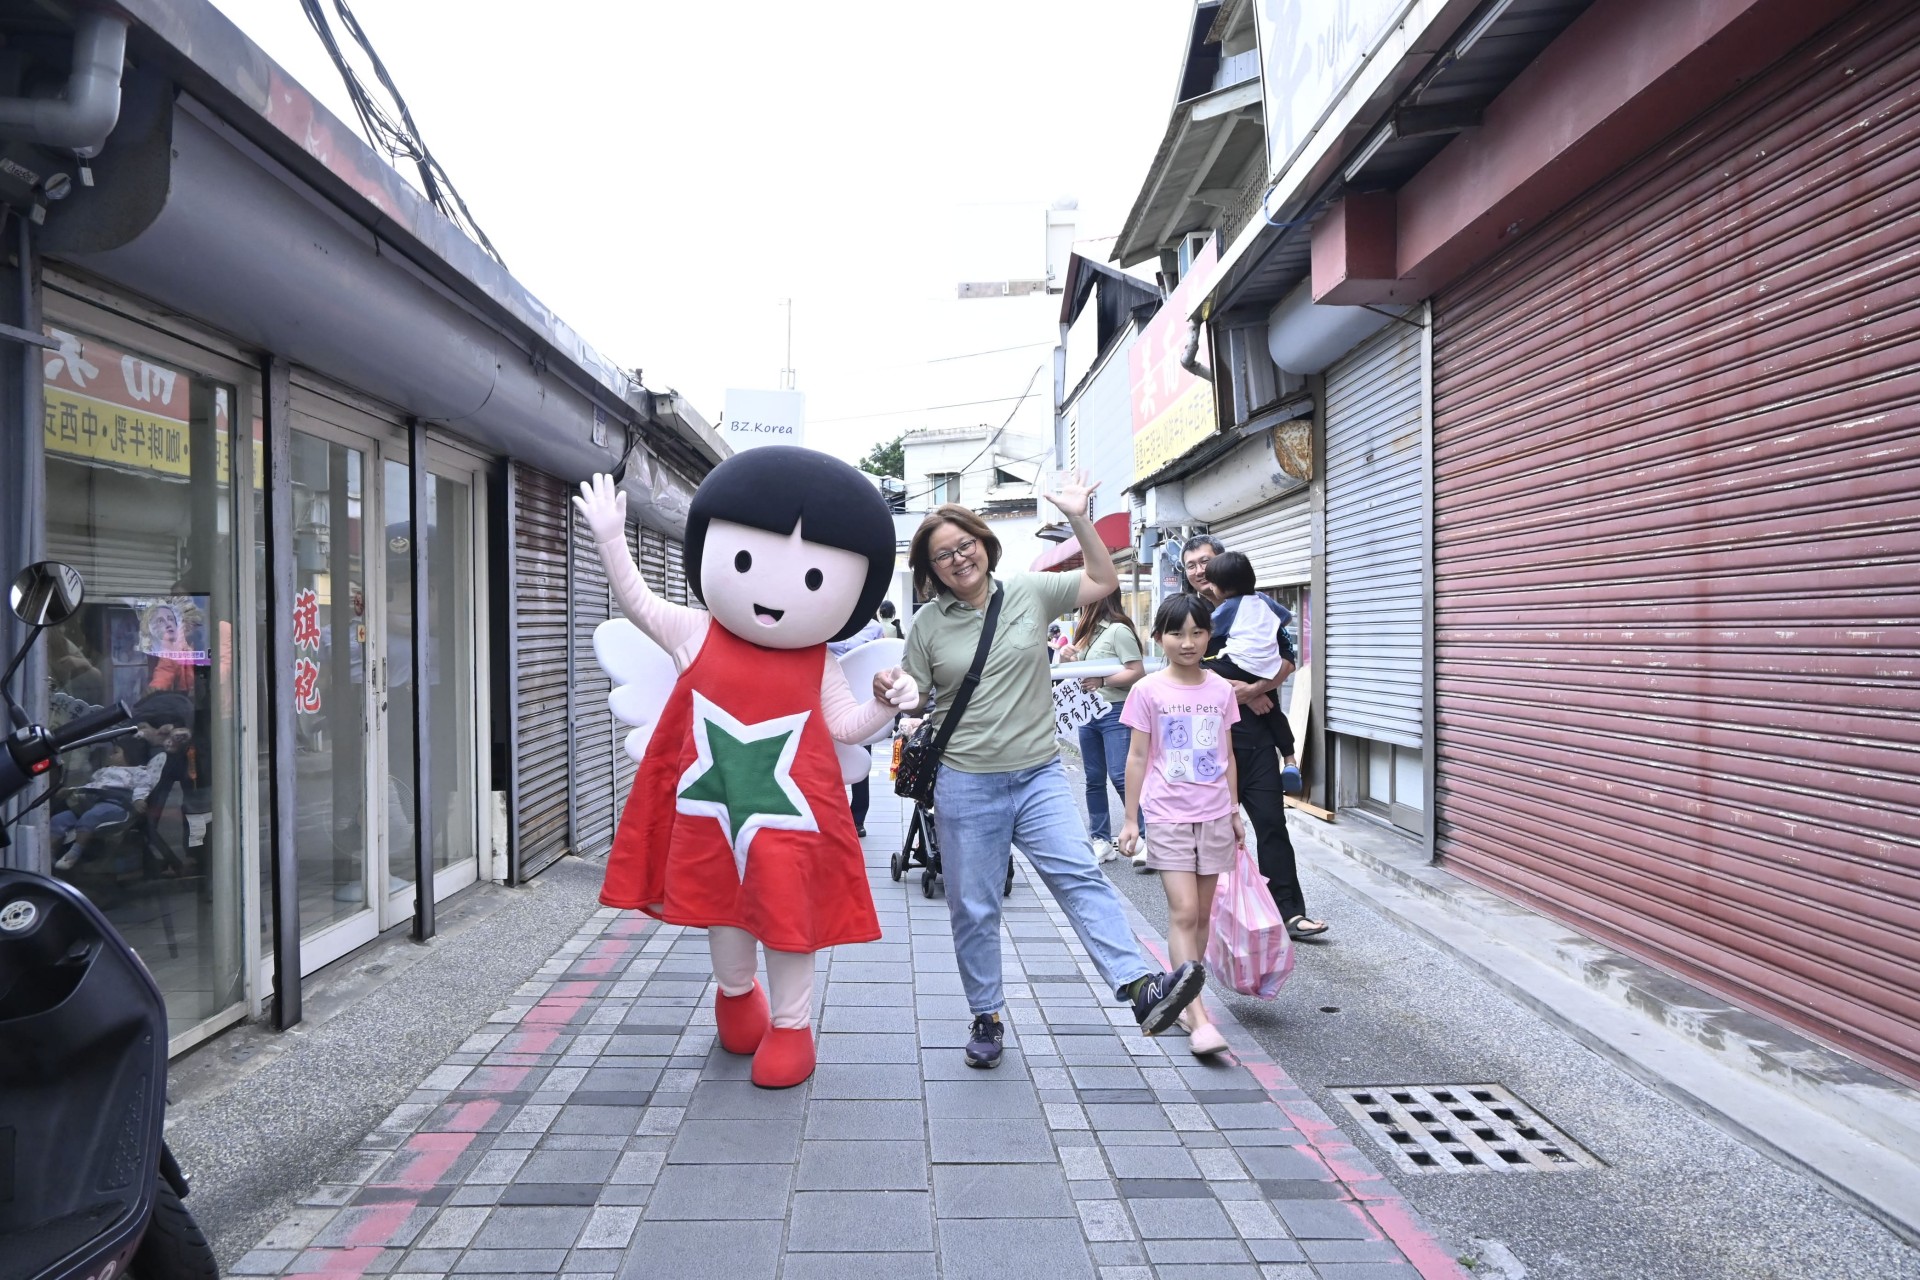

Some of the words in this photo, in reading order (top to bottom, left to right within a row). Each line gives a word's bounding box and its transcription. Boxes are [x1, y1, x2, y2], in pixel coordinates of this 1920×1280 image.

[730, 420, 793, 434] BZ.Korea
[293, 589, 321, 712] 旗袍
[1162, 704, 1192, 714] Little
[1196, 704, 1218, 713] Pets
